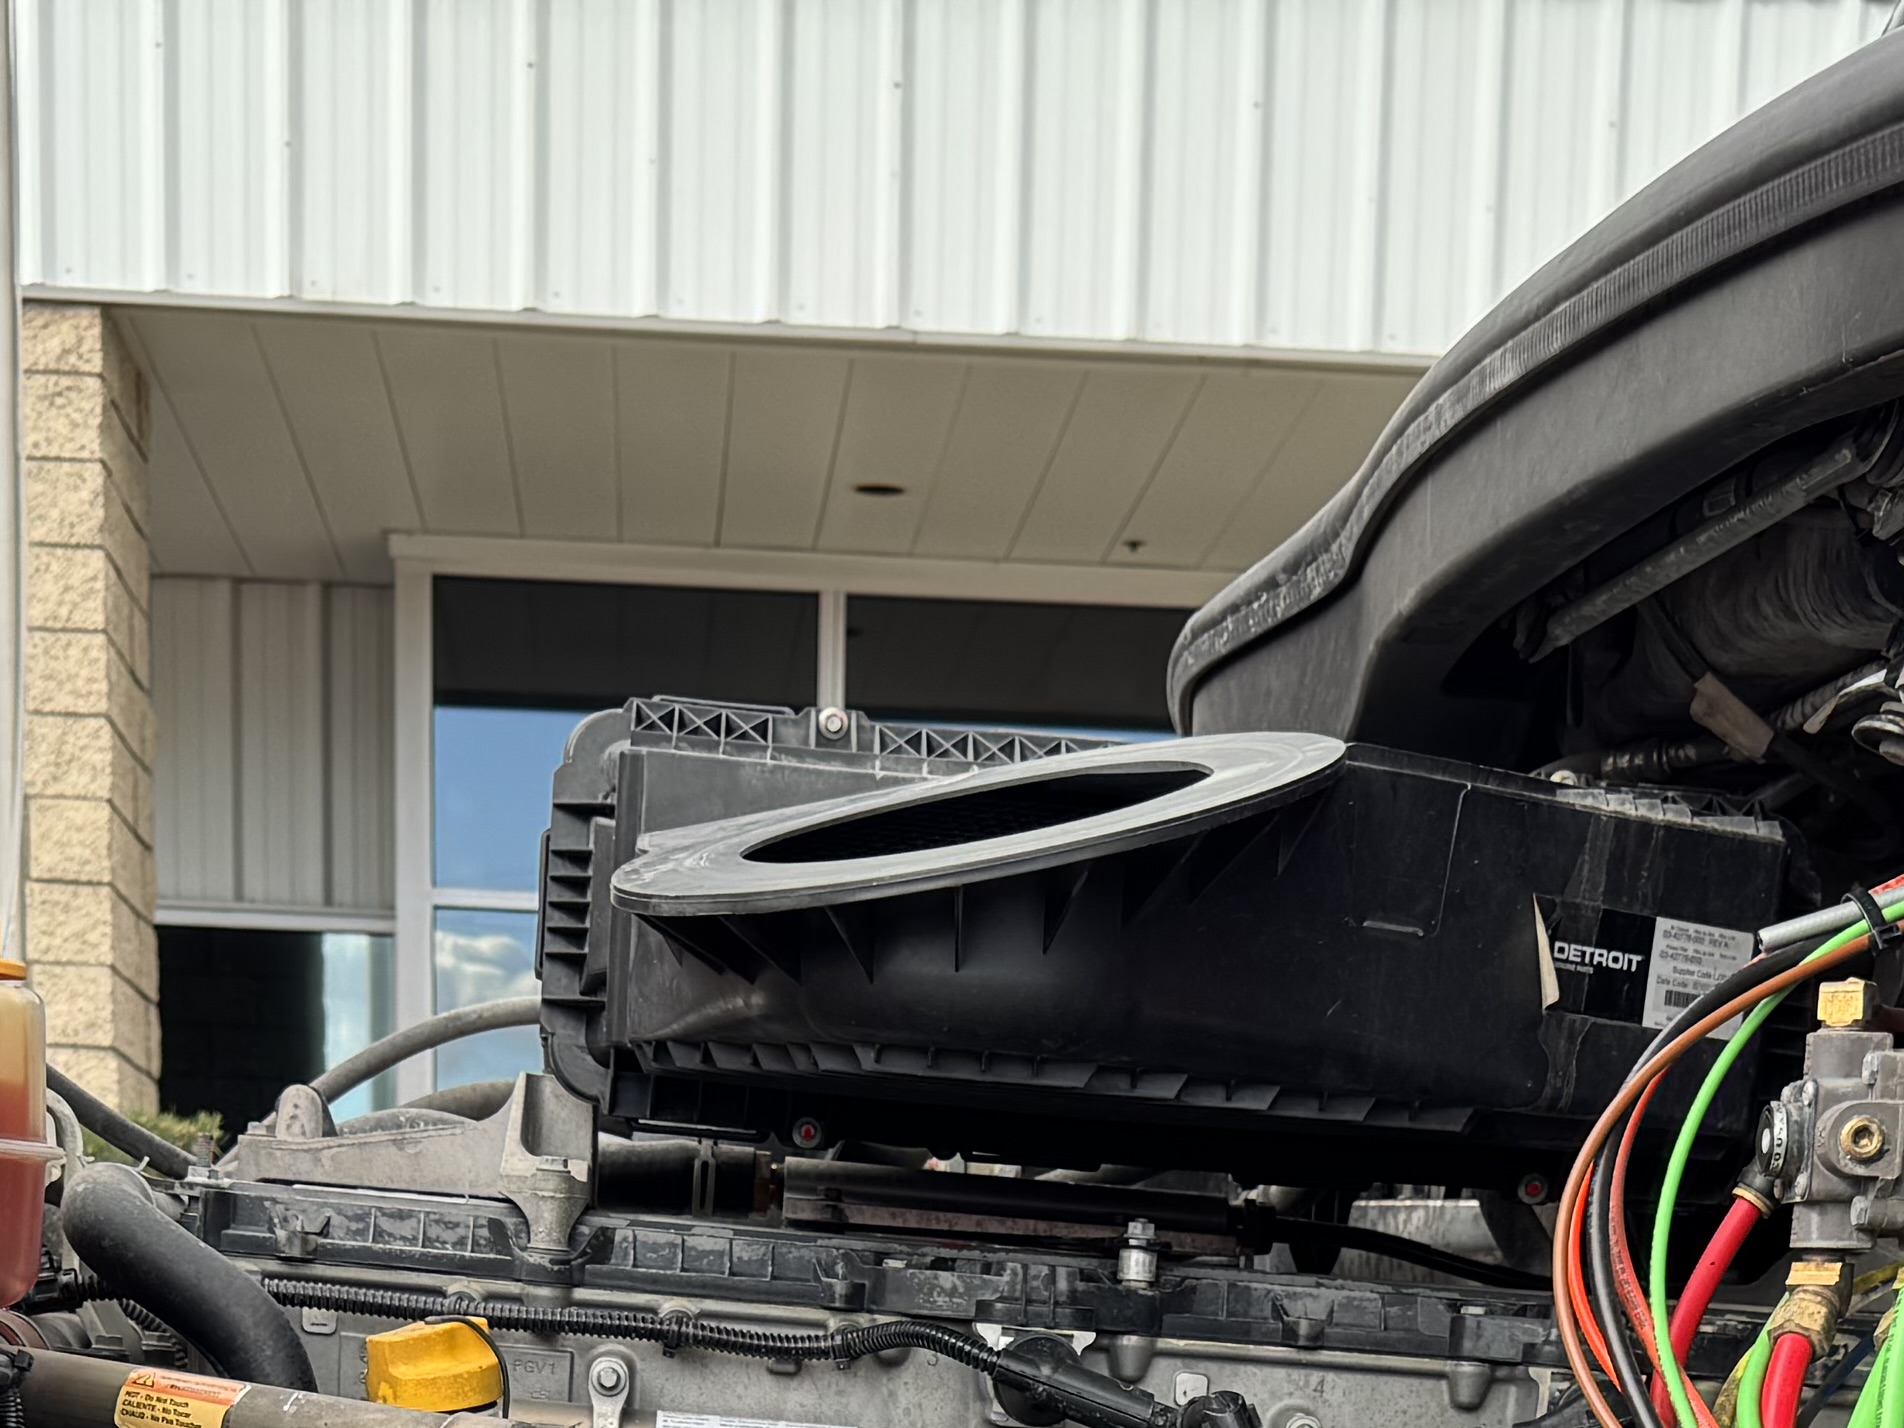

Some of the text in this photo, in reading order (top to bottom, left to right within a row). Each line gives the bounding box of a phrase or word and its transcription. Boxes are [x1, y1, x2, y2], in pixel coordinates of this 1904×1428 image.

[1553, 941, 1643, 973] DETROIT
[1656, 975, 1670, 986] Date
[122, 1400, 192, 1418] CALIENTE No Tocar
[144, 1393, 154, 1401] Do
[156, 1395, 168, 1404] Not
[169, 1398, 189, 1408] Touch
[120, 1408, 145, 1419] CHAUD
[162, 1416, 174, 1425] Pas
